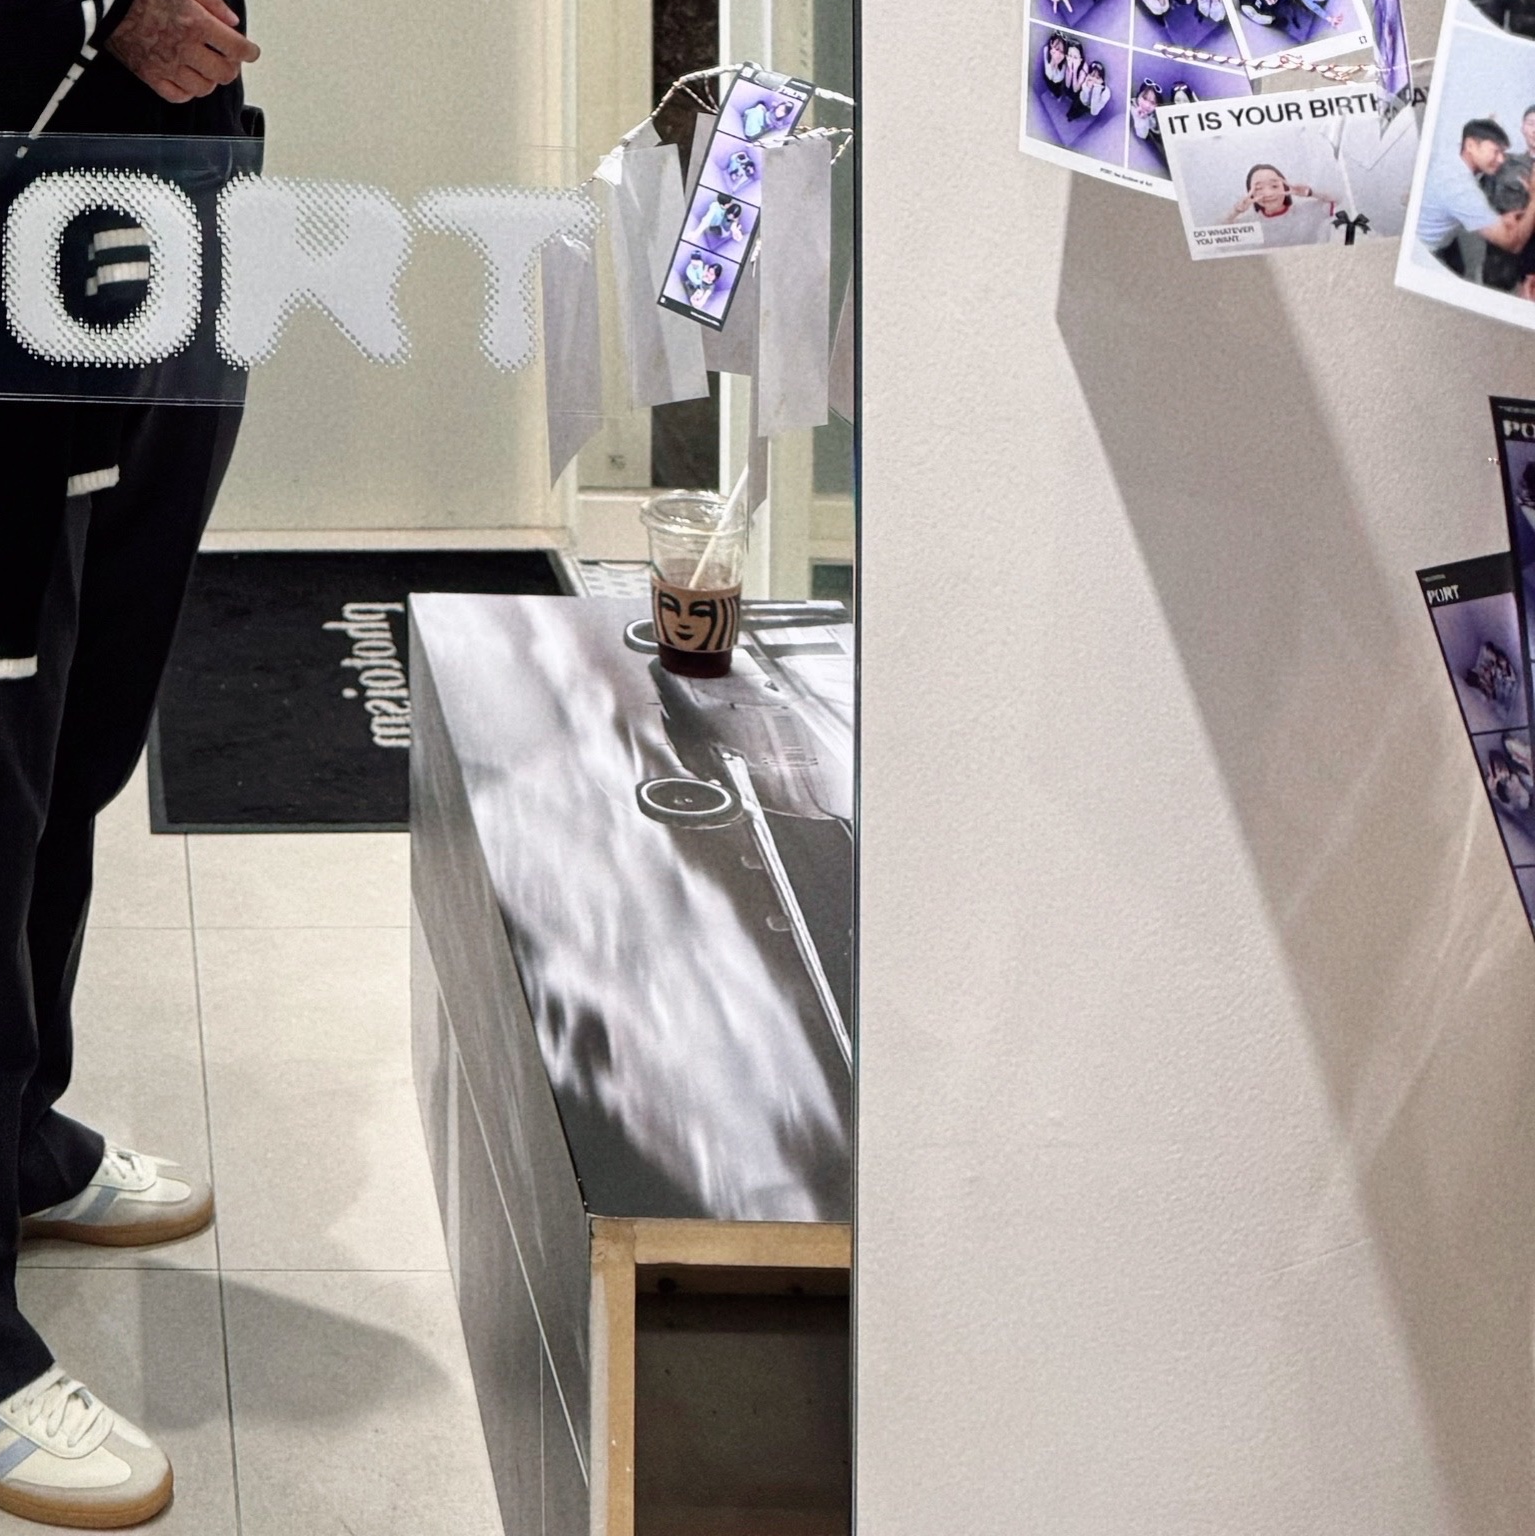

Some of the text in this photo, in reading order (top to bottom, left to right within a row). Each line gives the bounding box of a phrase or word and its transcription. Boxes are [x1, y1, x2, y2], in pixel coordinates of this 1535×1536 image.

[1168, 115, 1189, 135] IT
[1199, 111, 1222, 131] IS
[1228, 102, 1303, 127] YOUR
[1426, 584, 1460, 604] PORT
